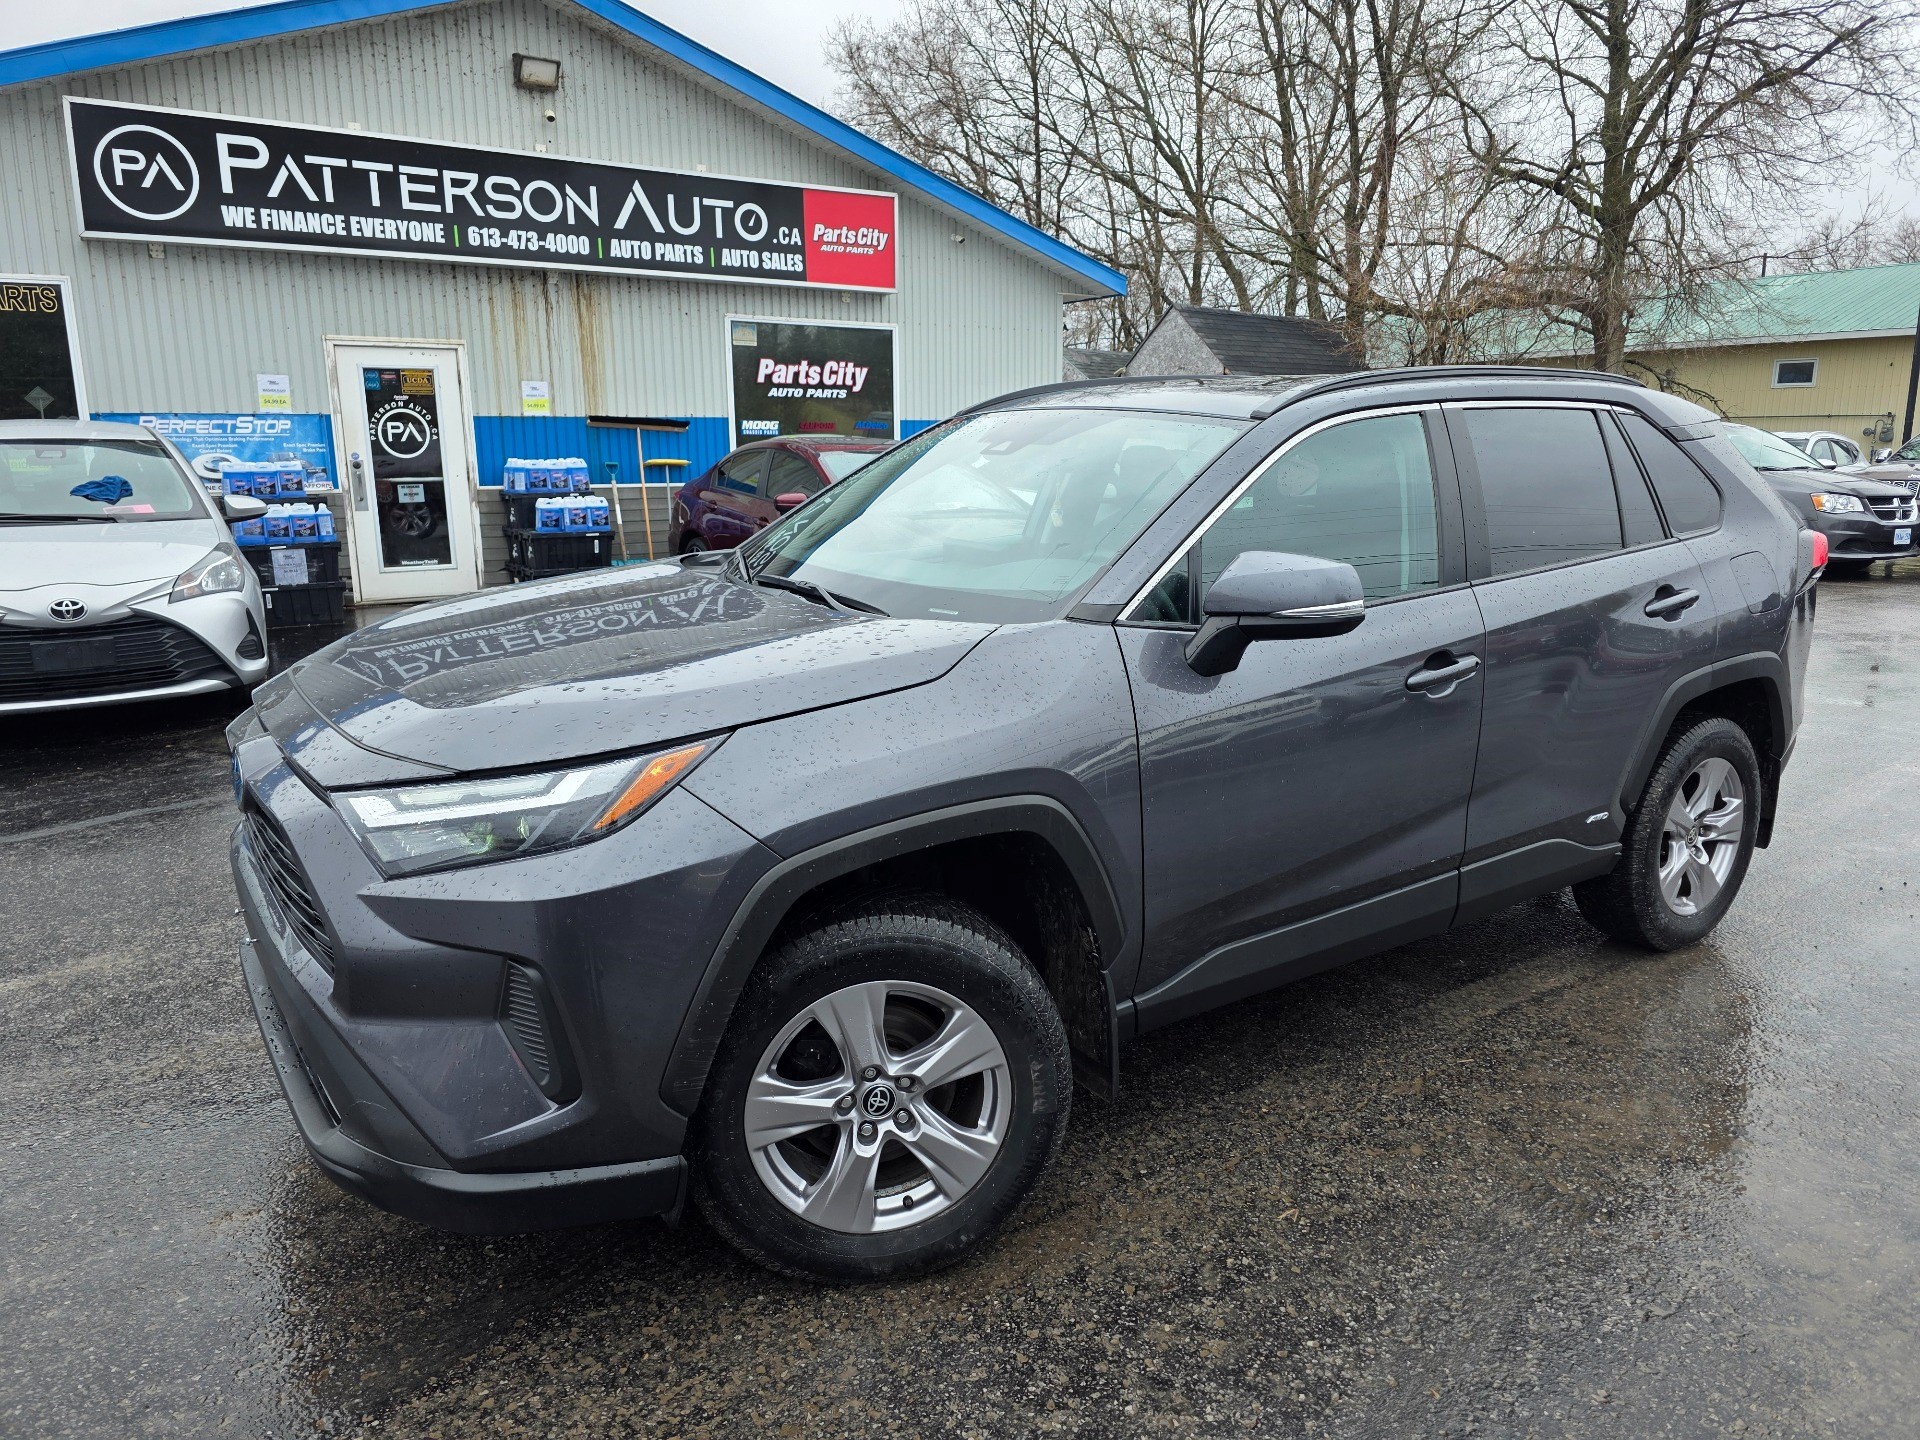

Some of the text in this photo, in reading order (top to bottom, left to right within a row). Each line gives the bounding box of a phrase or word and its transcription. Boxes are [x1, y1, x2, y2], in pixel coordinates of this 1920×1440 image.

[111, 147, 185, 190] PA
[216, 132, 600, 226] PATTERSON
[613, 179, 768, 242] AUTO
[220, 204, 803, 272] WE FINANCE EVERYONE 613-473-4000 AUTO PARTS AUTO SALES
[820, 244, 874, 255] AUTO PARTS
[768, 387, 847, 399] AUTO PARTS
[369, 400, 404, 441] PATTERSON
[408, 402, 432, 421] AUTO
[386, 421, 424, 442] PA
[741, 420, 779, 430] MOOG
